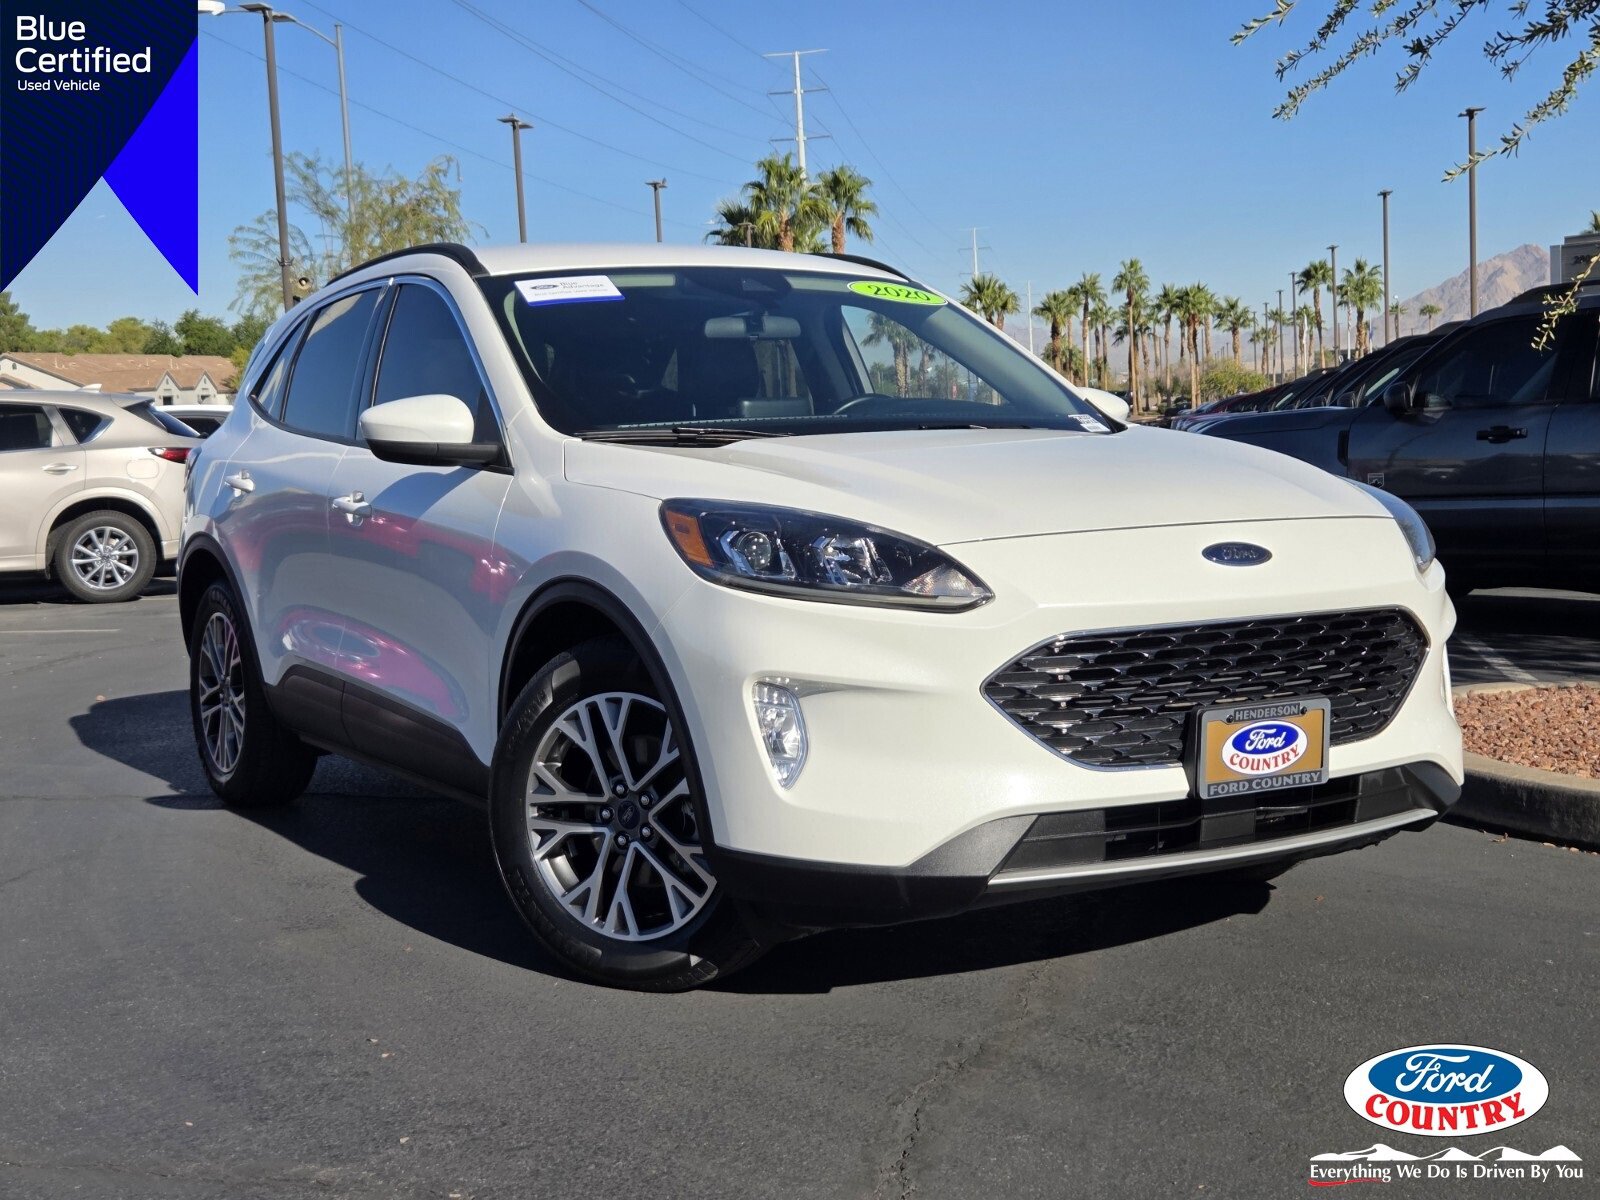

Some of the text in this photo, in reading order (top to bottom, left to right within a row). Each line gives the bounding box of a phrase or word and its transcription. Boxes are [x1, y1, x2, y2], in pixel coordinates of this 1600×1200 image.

[867, 284, 931, 301] 2020
[1234, 704, 1299, 721] HENDERSON
[1245, 728, 1287, 751] Ford
[1229, 744, 1300, 771] COUNTRY
[1209, 771, 1321, 796] FORD COUNTRY
